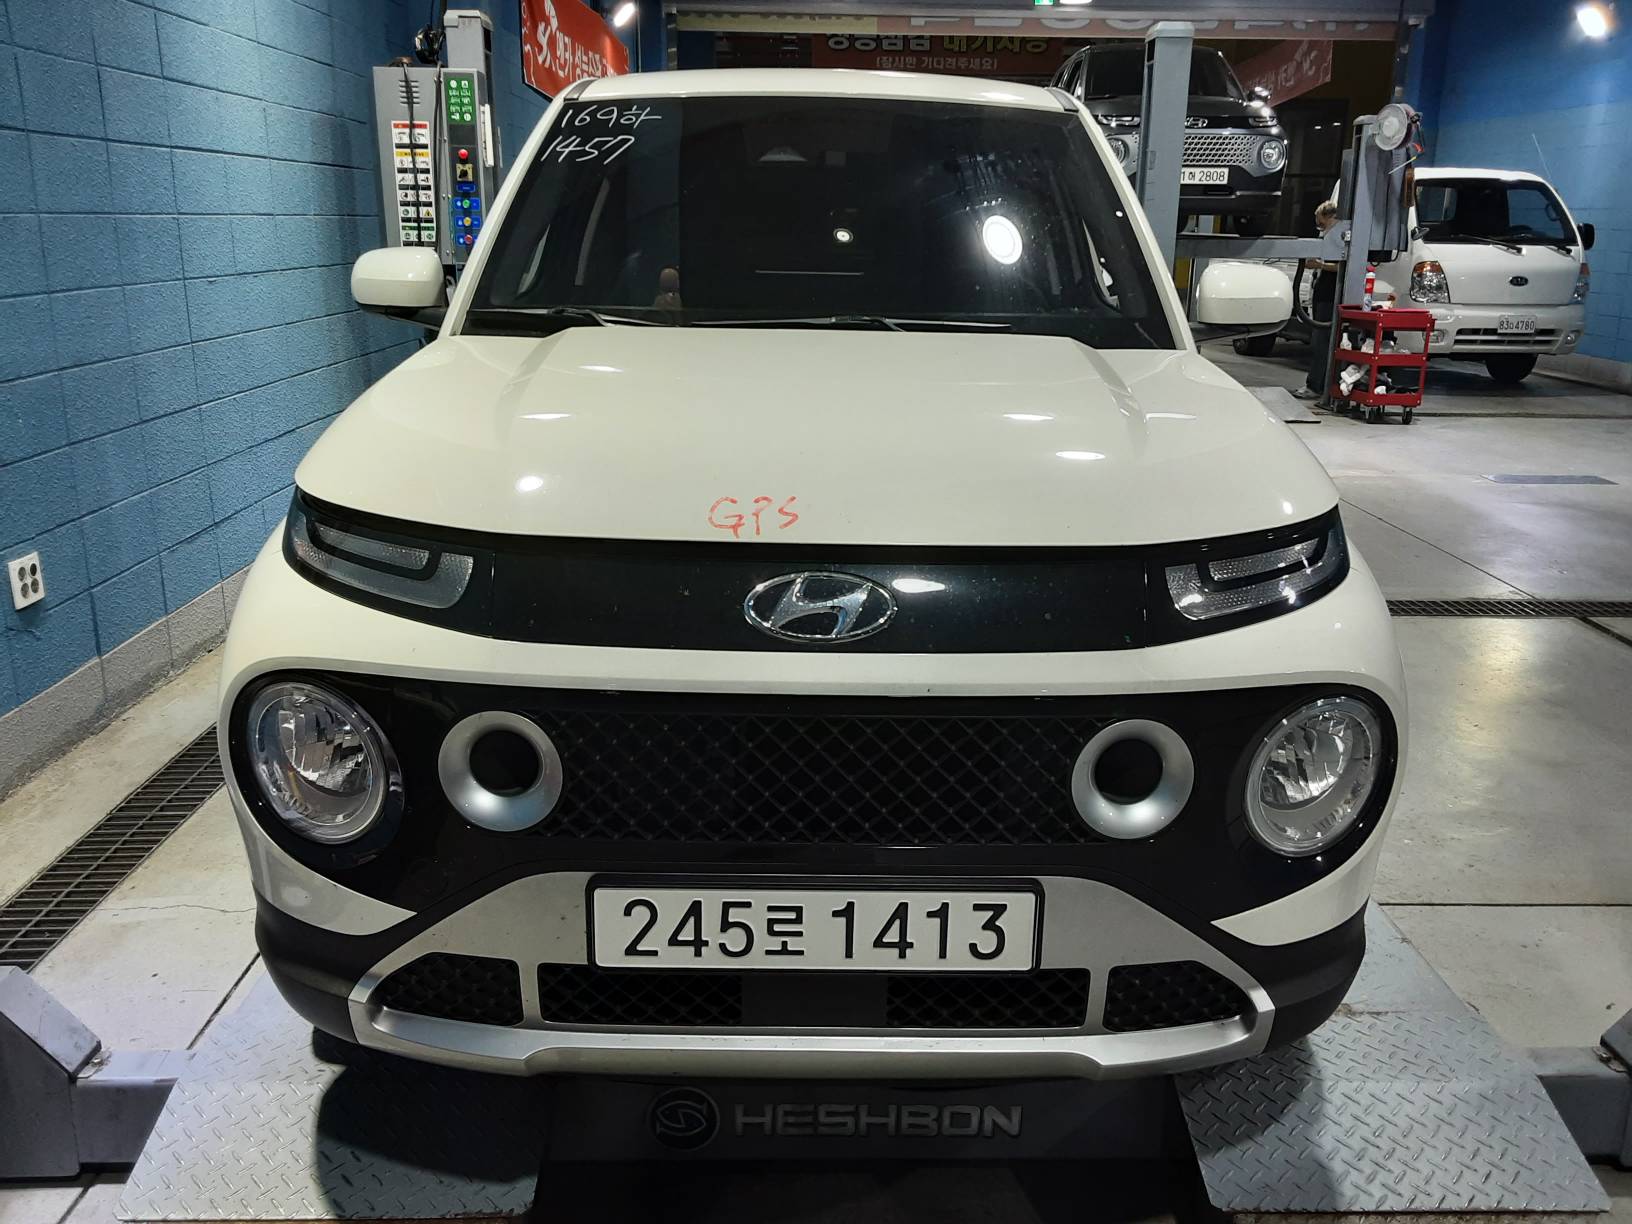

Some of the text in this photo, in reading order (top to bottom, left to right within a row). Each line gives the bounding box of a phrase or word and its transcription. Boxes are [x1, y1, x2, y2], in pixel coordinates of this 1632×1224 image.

[561, 104, 662, 129] 169하
[540, 135, 635, 165] 1457
[1198, 170, 1226, 182] 2808
[708, 496, 799, 539] GPS
[622, 898, 1009, 961] 245로 1413
[734, 1103, 1024, 1138] HESHBON
